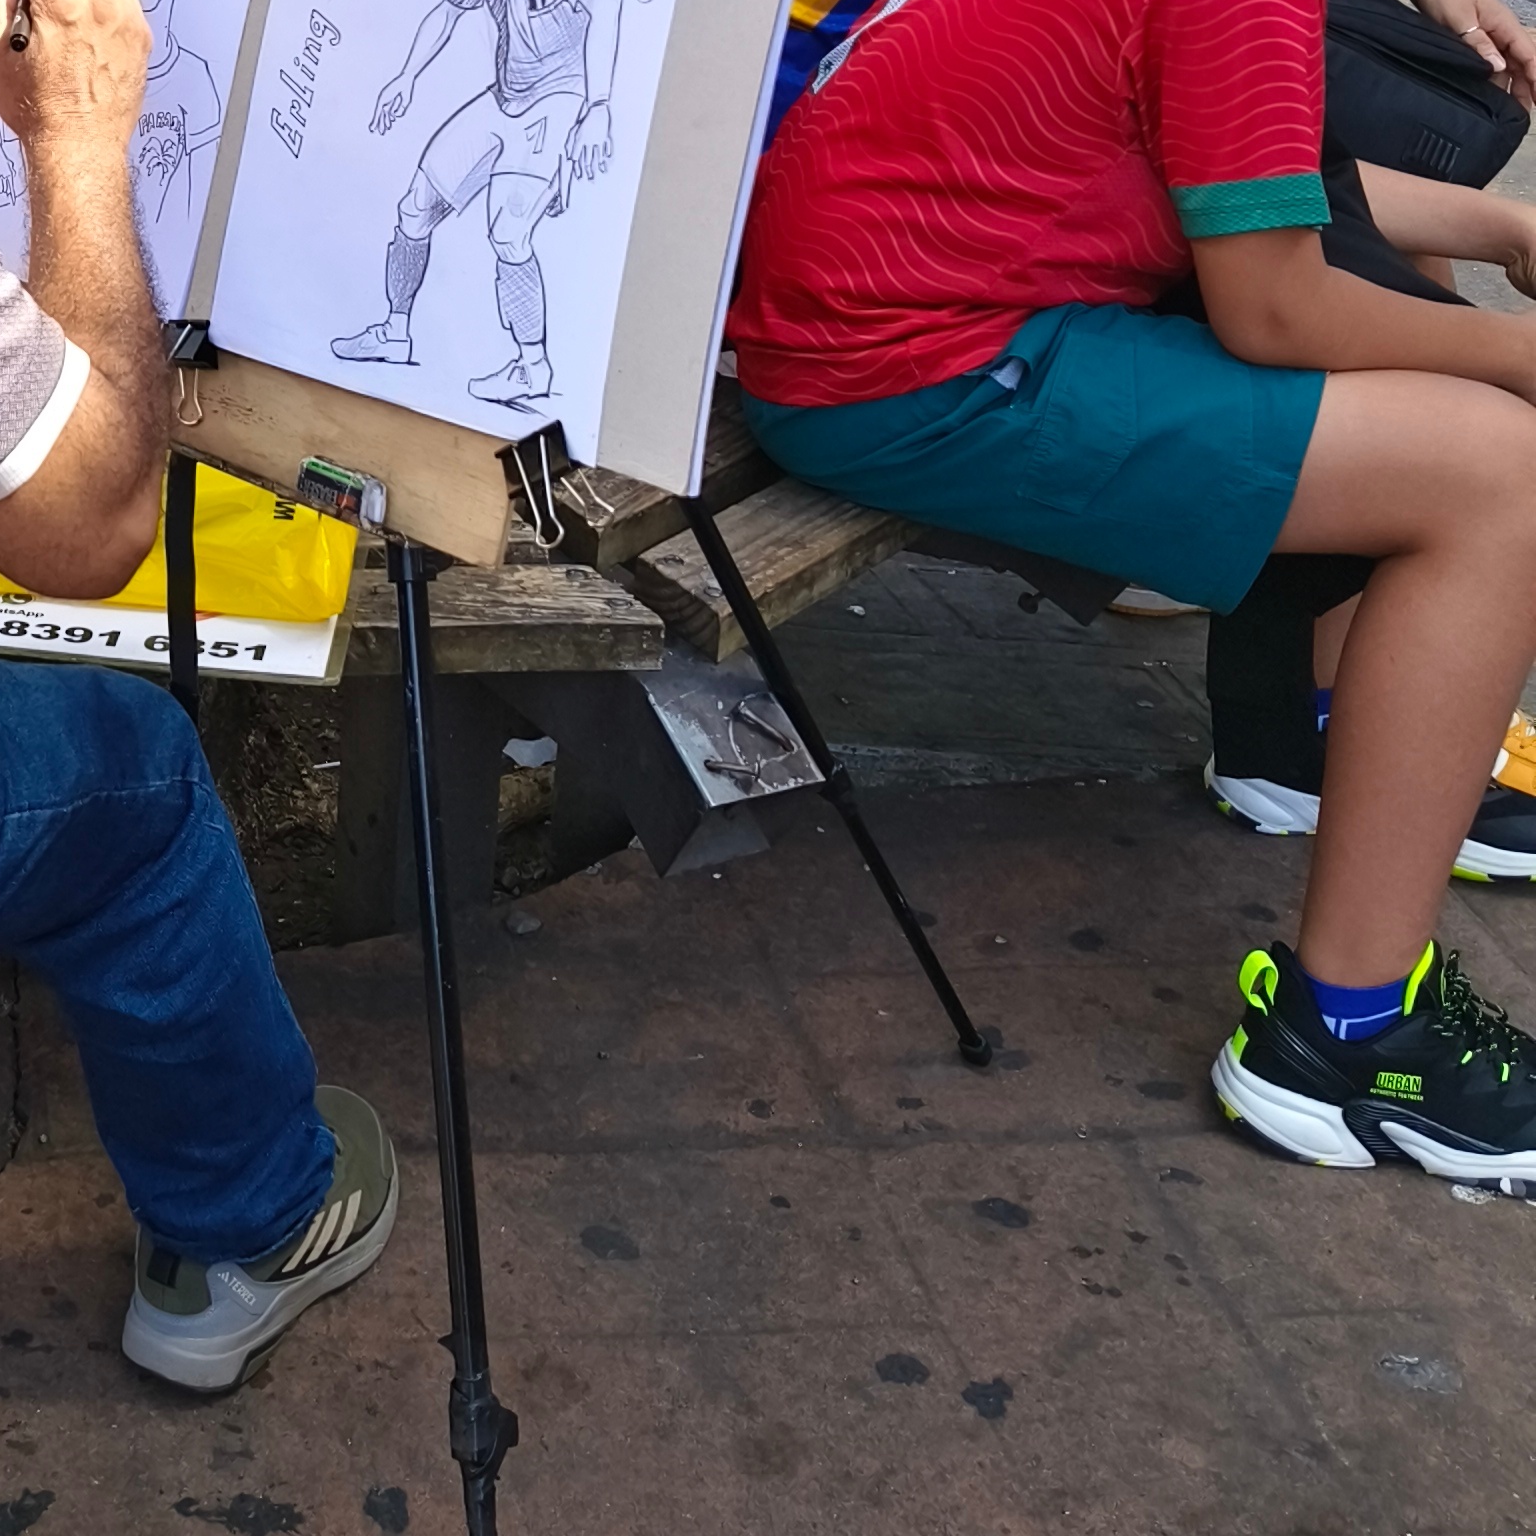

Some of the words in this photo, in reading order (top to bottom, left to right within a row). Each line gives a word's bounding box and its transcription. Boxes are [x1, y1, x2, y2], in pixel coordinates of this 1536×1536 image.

[270, 8, 342, 159] Erling
[1376, 1071, 1423, 1094] URBAN
[228, 1276, 258, 1307] TERREX
